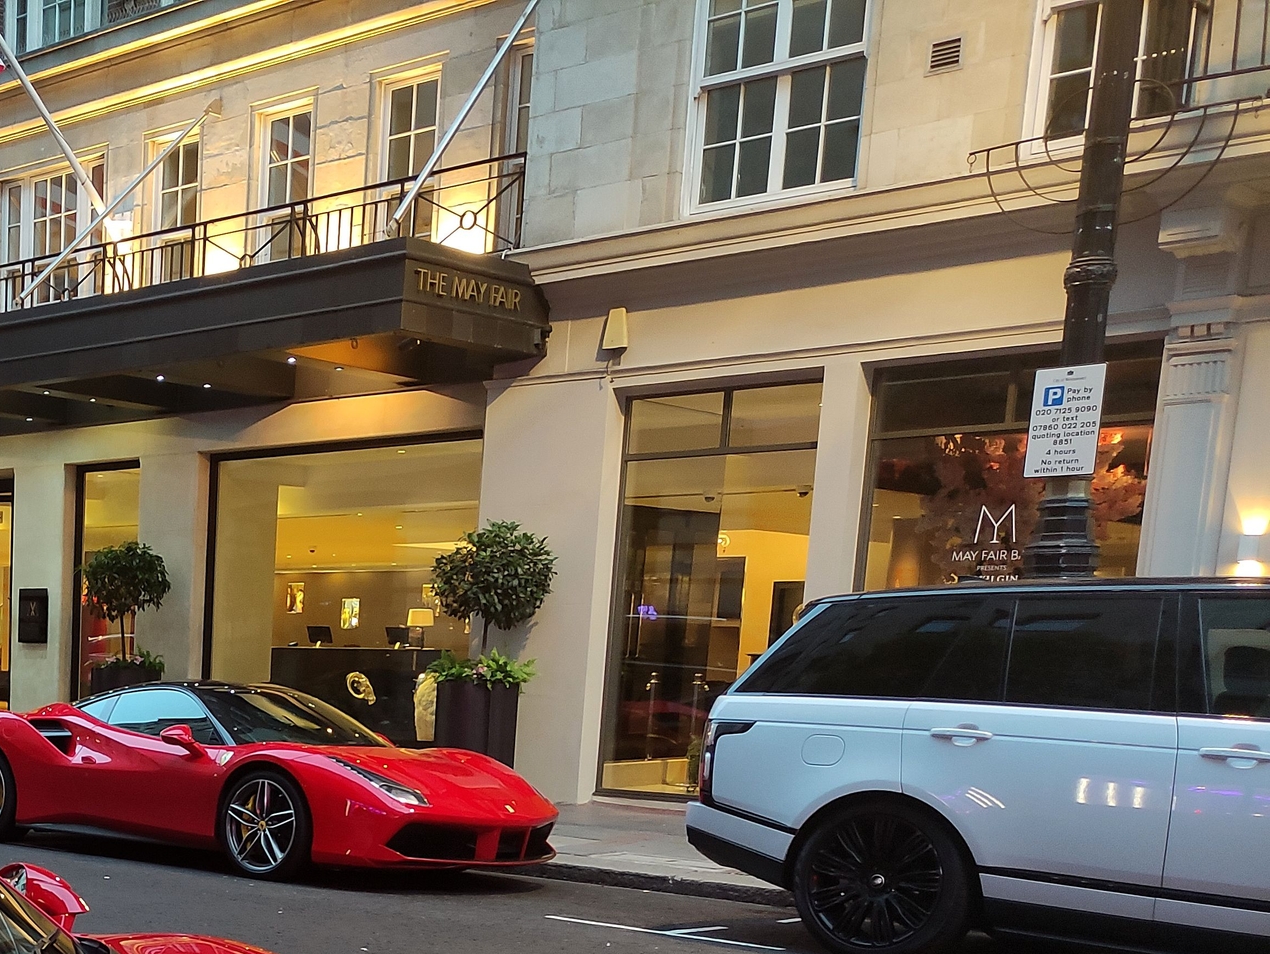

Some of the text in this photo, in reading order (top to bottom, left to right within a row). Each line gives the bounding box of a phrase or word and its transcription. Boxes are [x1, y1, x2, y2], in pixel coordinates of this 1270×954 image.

[415, 267, 521, 312] THE MAY FAIR
[1047, 388, 1062, 405] P
[1066, 395, 1091, 403] phone
[1054, 407, 1072, 415] 7125
[1075, 405, 1097, 413] 9090
[1061, 422, 1078, 430] 022
[1031, 429, 1095, 440] quoting location
[1033, 466, 1058, 474] within
[951, 550, 979, 562] MAY
[981, 549, 1008, 561] FAIR
